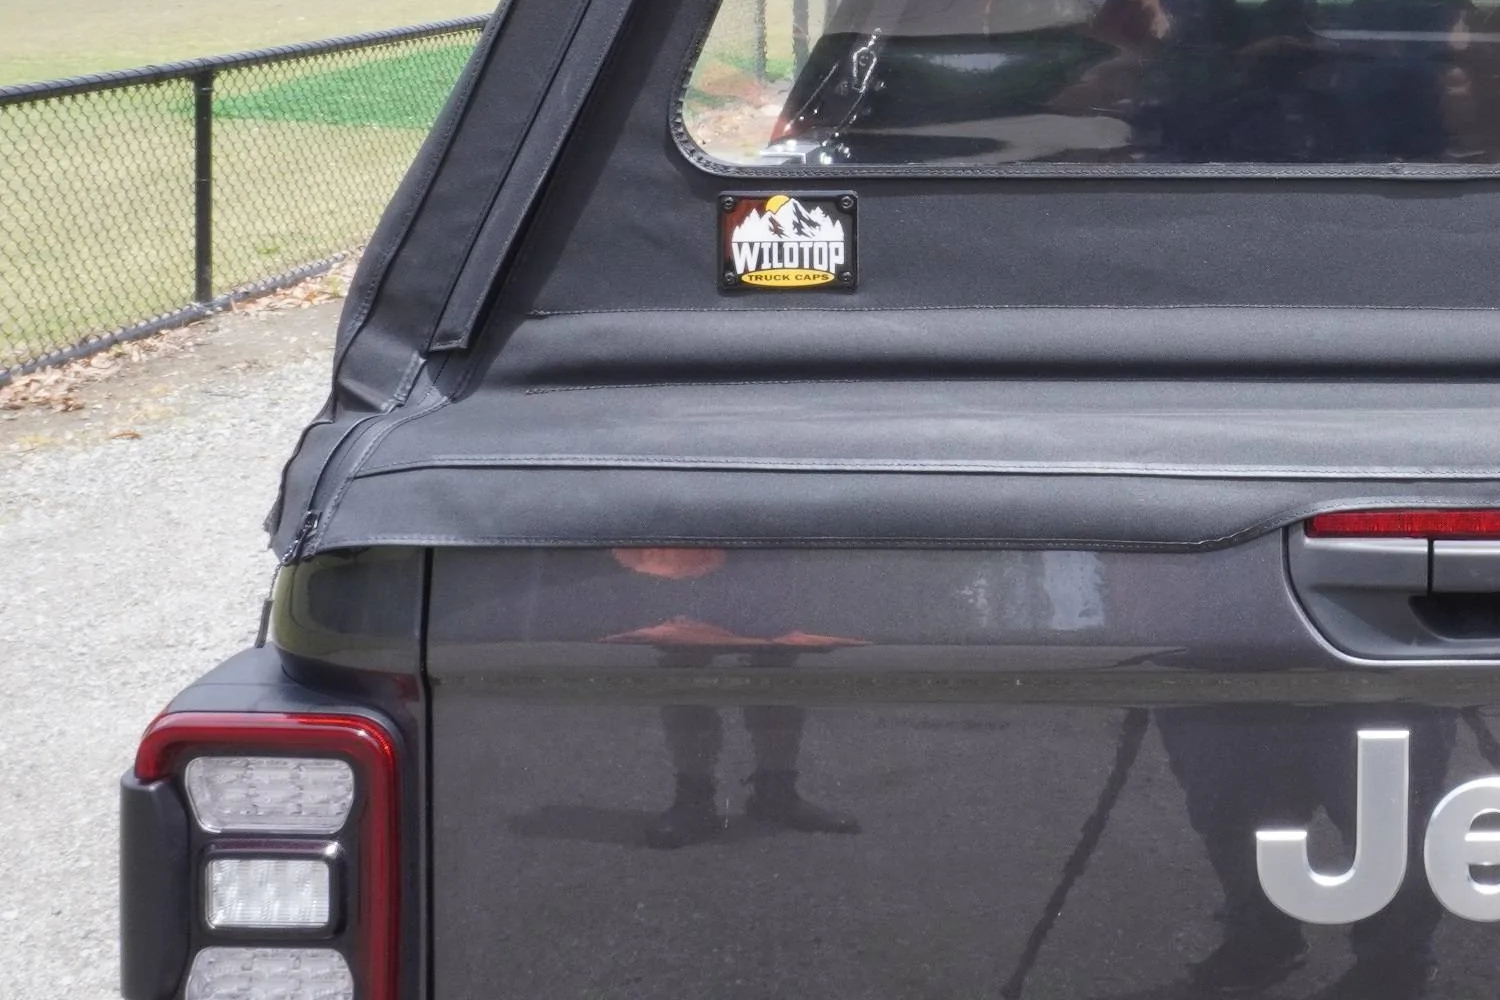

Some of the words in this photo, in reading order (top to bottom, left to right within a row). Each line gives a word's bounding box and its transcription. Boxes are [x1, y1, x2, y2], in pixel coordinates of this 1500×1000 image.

[732, 241, 845, 274] WILDTOP
[747, 273, 791, 282] TRUCK
[794, 273, 830, 281] CAPS
